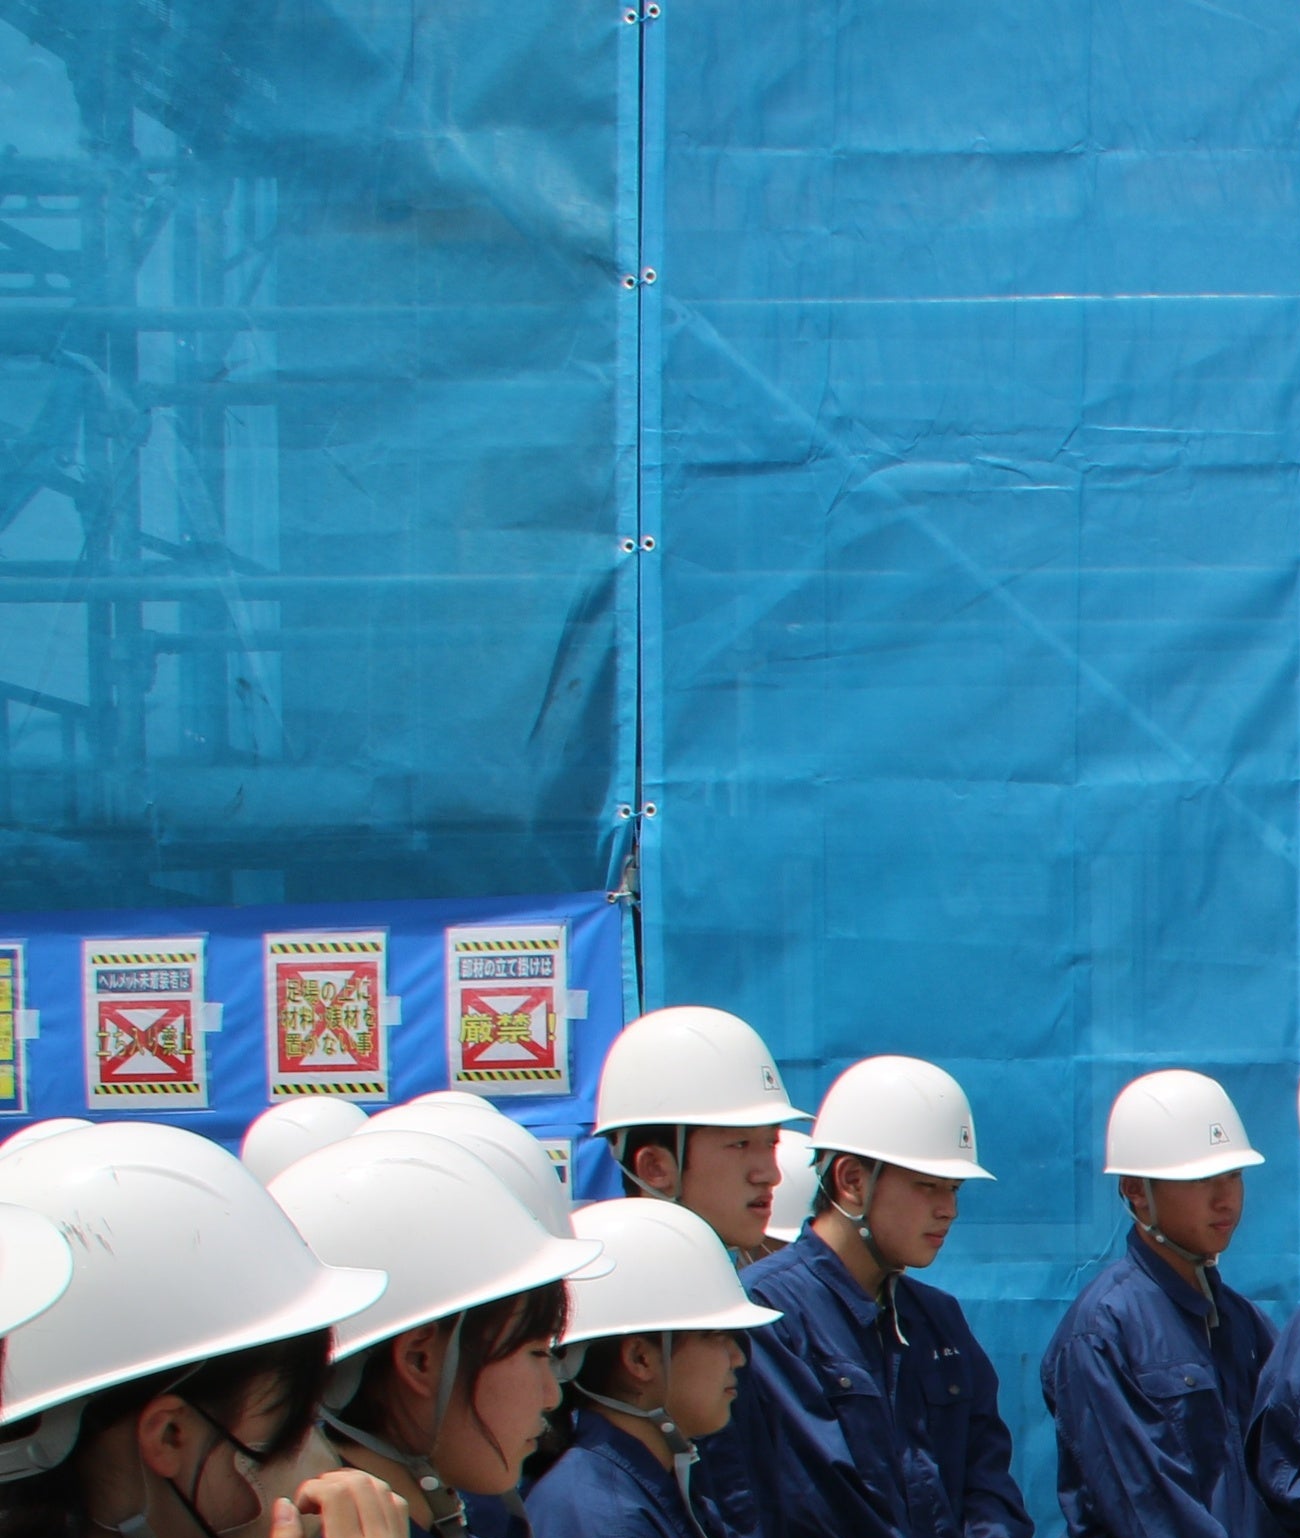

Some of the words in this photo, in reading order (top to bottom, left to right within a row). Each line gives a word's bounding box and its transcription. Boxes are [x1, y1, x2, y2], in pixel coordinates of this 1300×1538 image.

[461, 956, 553, 979] 部材の立て掛けは
[285, 976, 372, 1004] 足場の上に
